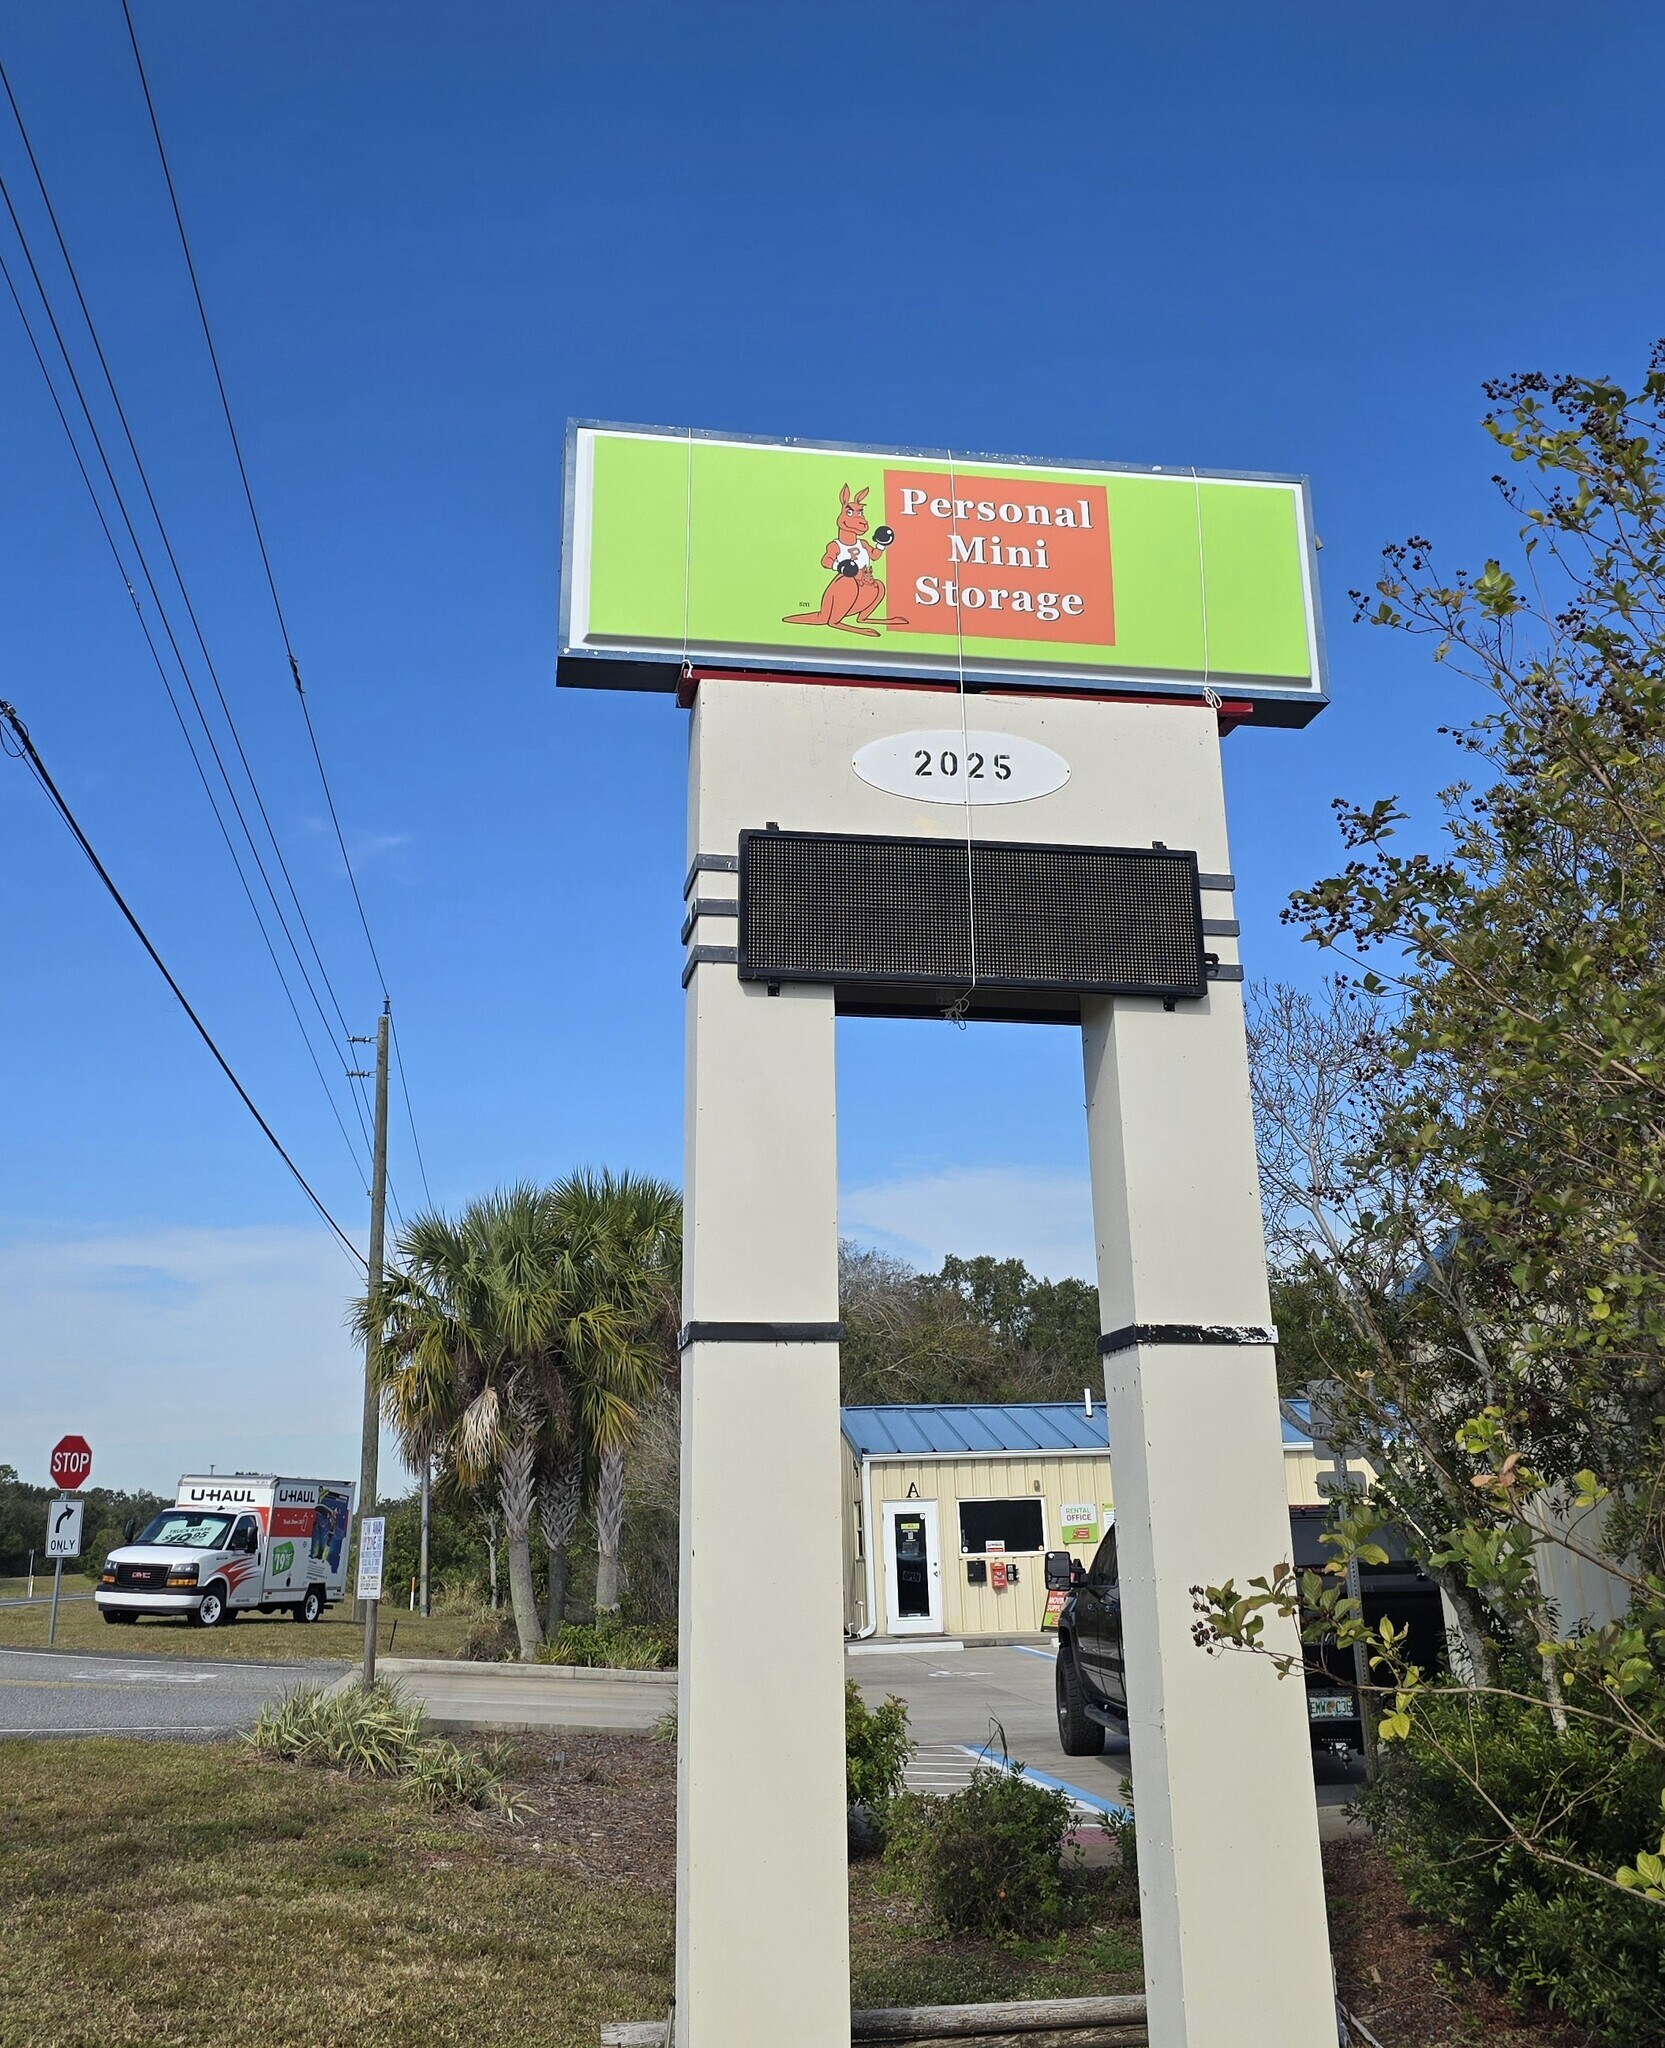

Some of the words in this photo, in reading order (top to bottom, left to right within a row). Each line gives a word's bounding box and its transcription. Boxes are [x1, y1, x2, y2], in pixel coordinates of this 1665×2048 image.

[900, 488, 1094, 529] Personal
[946, 534, 1050, 569] Mini
[915, 576, 1085, 621] Storage
[914, 750, 1011, 781] 2025
[53, 1452, 89, 1473] STOP
[191, 1488, 256, 1503] U-HAUL
[279, 1489, 316, 1503] U-HAUL
[906, 1482, 920, 1498] A
[1066, 1513, 1092, 1521] OFFICE
[50, 1540, 76, 1551] ONLY
[131, 1571, 151, 1579] GMC
[1048, 1596, 1065, 1605] MOVIN
